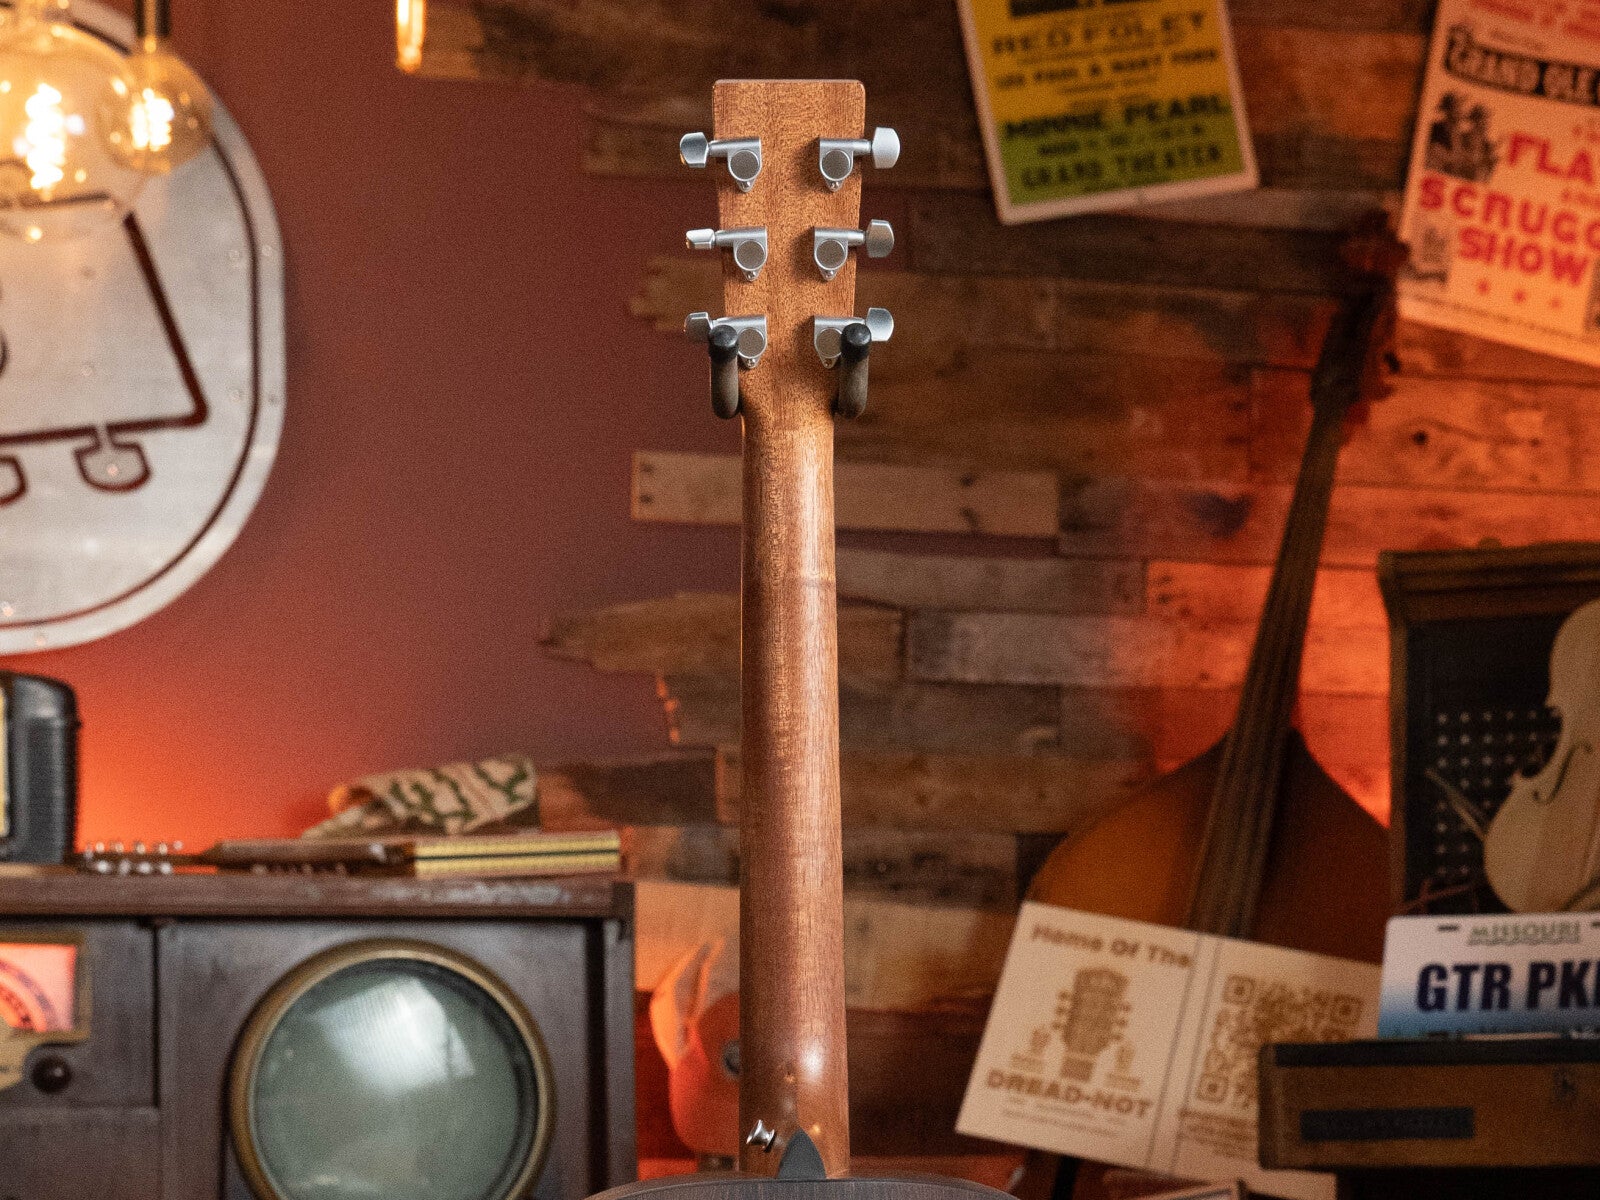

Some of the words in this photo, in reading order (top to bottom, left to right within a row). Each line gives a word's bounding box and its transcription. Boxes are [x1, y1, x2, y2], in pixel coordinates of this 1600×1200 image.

[1457, 226, 1589, 288] SHOW
[1469, 921, 1582, 946] MISSOURI
[1416, 961, 1513, 1013] GTR
[986, 1068, 1153, 1119] DREAD-NOT
